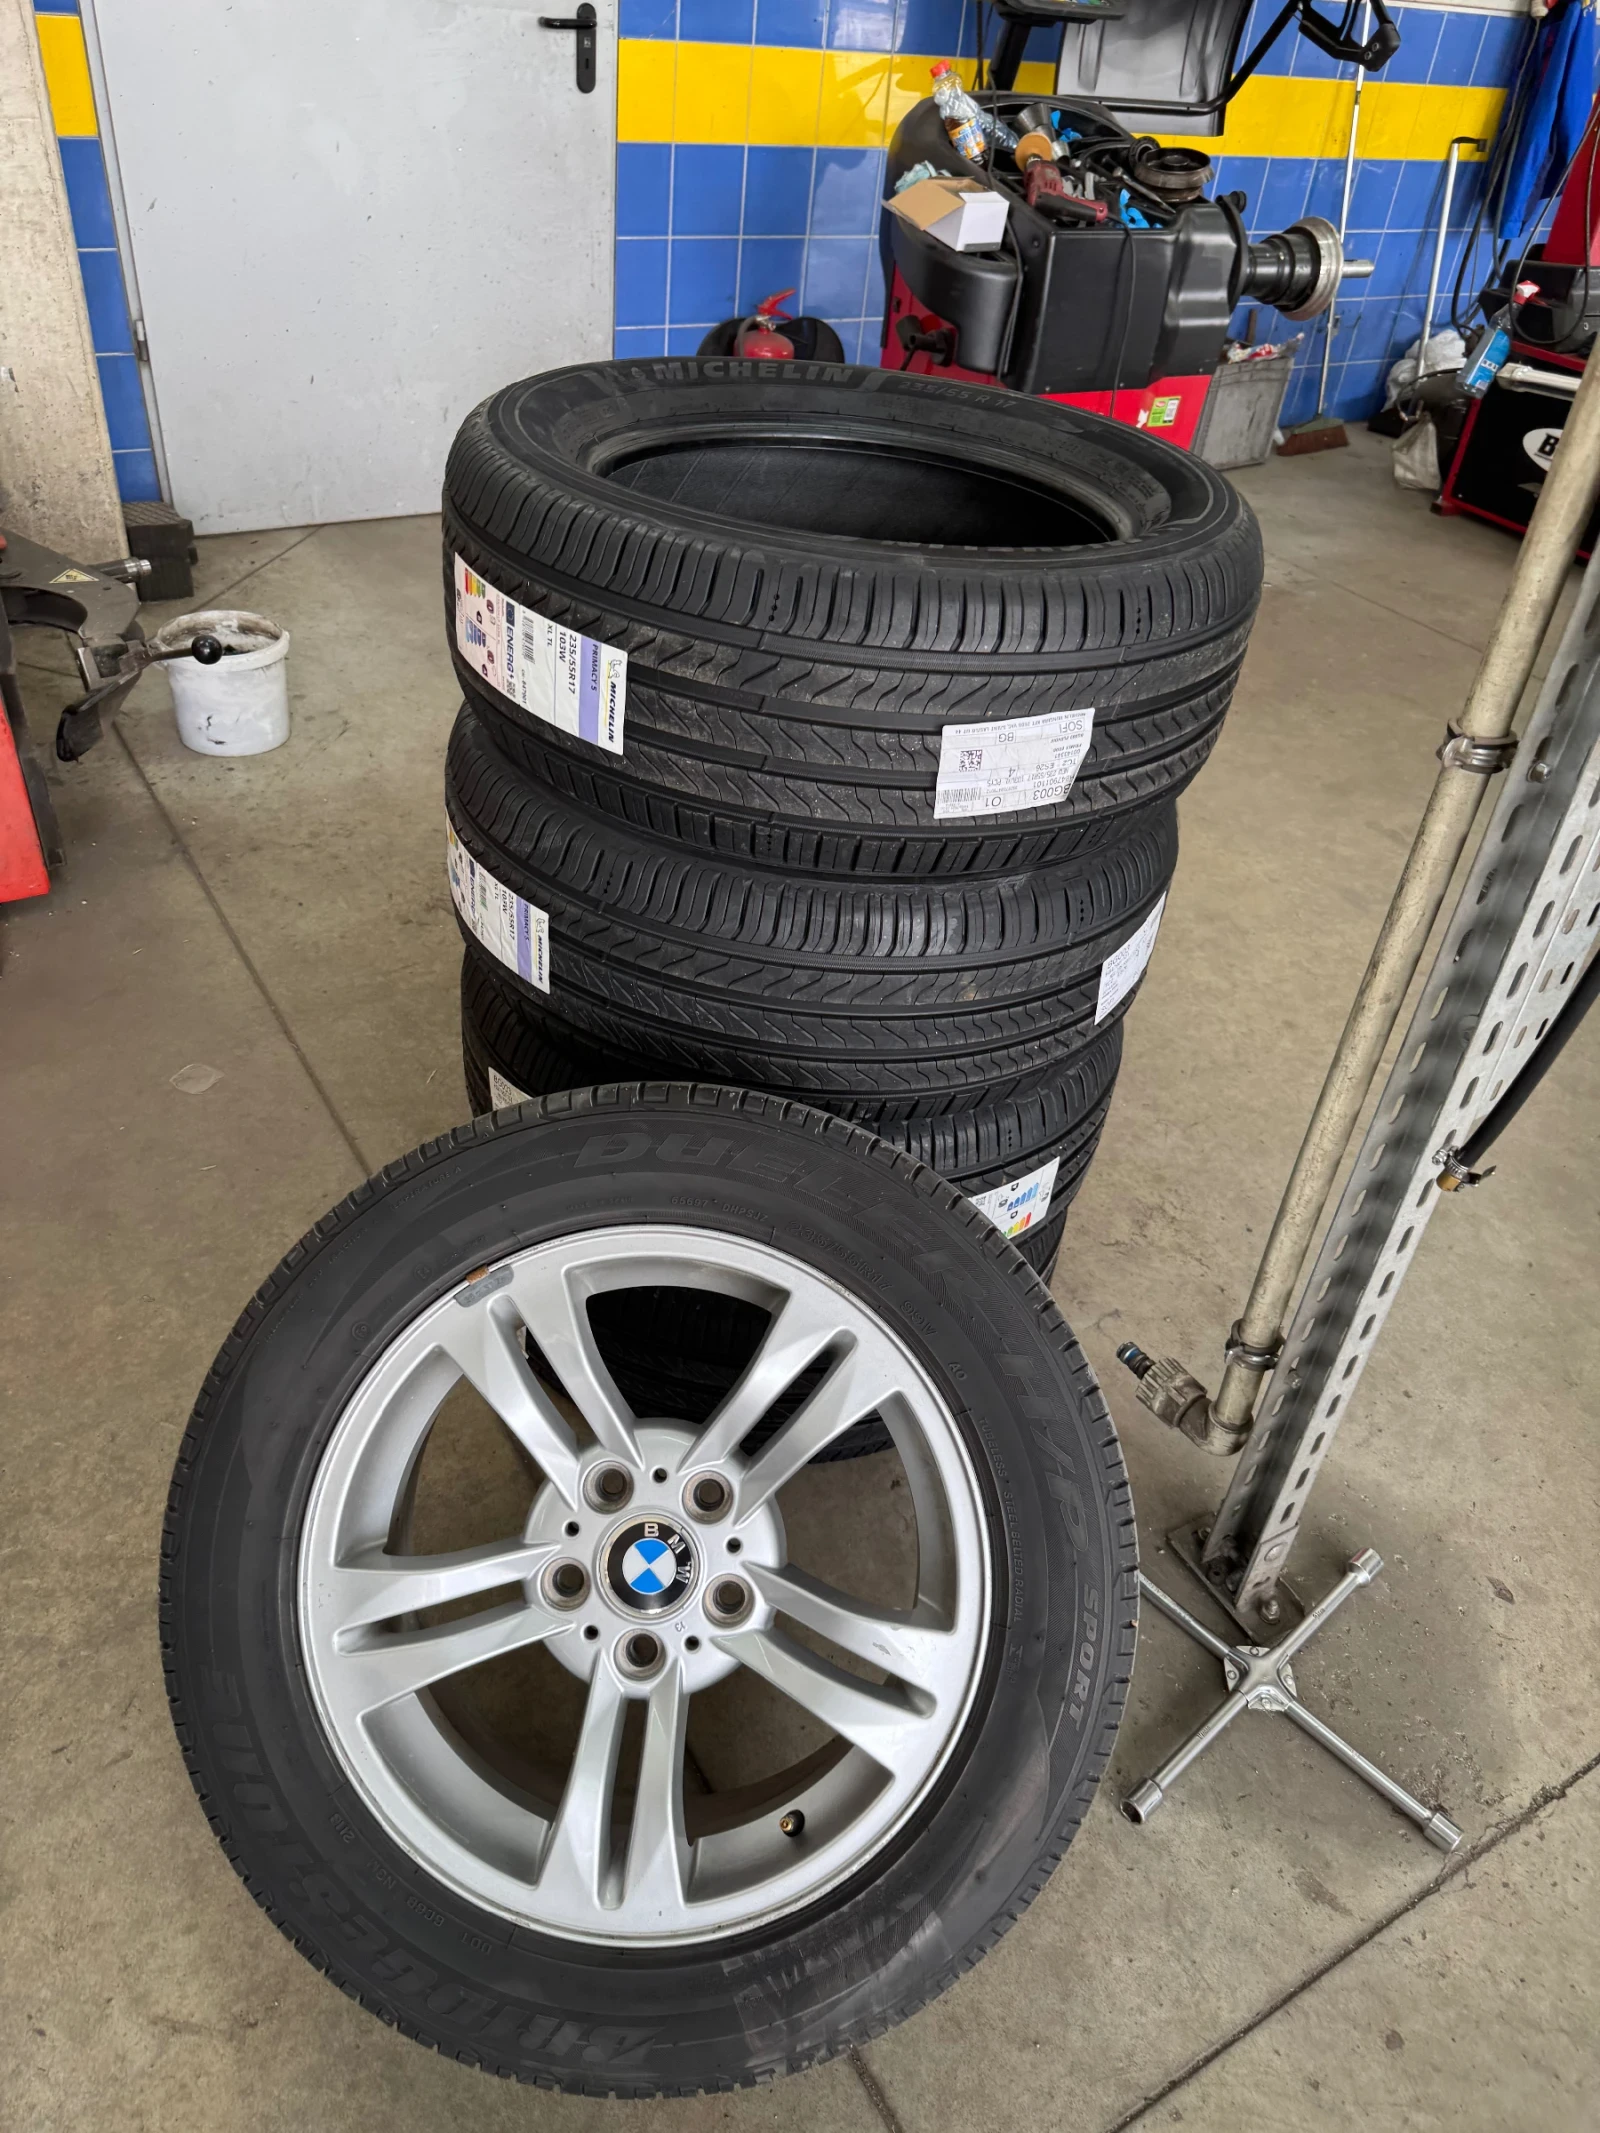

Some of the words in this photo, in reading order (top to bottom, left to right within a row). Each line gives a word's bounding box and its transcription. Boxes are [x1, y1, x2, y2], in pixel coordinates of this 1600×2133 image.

[654, 361, 855, 383] MICHELIN
[899, 380, 971, 402] 235/55
[995, 397, 1017, 409] 17
[547, 638, 553, 647] TL
[548, 624, 554, 635] XL
[559, 631, 567, 663] 103W
[568, 635, 577, 695] 235/55R17
[590, 643, 599, 683] PRIMACY
[607, 681, 617, 744] MICHELIN
[1059, 720, 1083, 733] SOFI
[998, 731, 1015, 743] BG
[1033, 783, 1070, 800] BG003
[536, 935, 544, 984] MICHELIN
[785, 1220, 893, 1291] 235/55R17
[900, 1300, 938, 1337] 99V
[573, 1131, 988, 1303] DUELER
[994, 1352, 1089, 1551] H/P
[1068, 1583, 1100, 1732] SPORT
[978, 1416, 1008, 1477] TUBELESS
[1003, 1491, 1018, 1529] STEEL
[643, 1522, 692, 1584] BMW
[1011, 1531, 1024, 1575] BELTED
[1013, 1578, 1025, 1623] RADIAL
[208, 1669, 664, 2065] BRIDGESTONE
